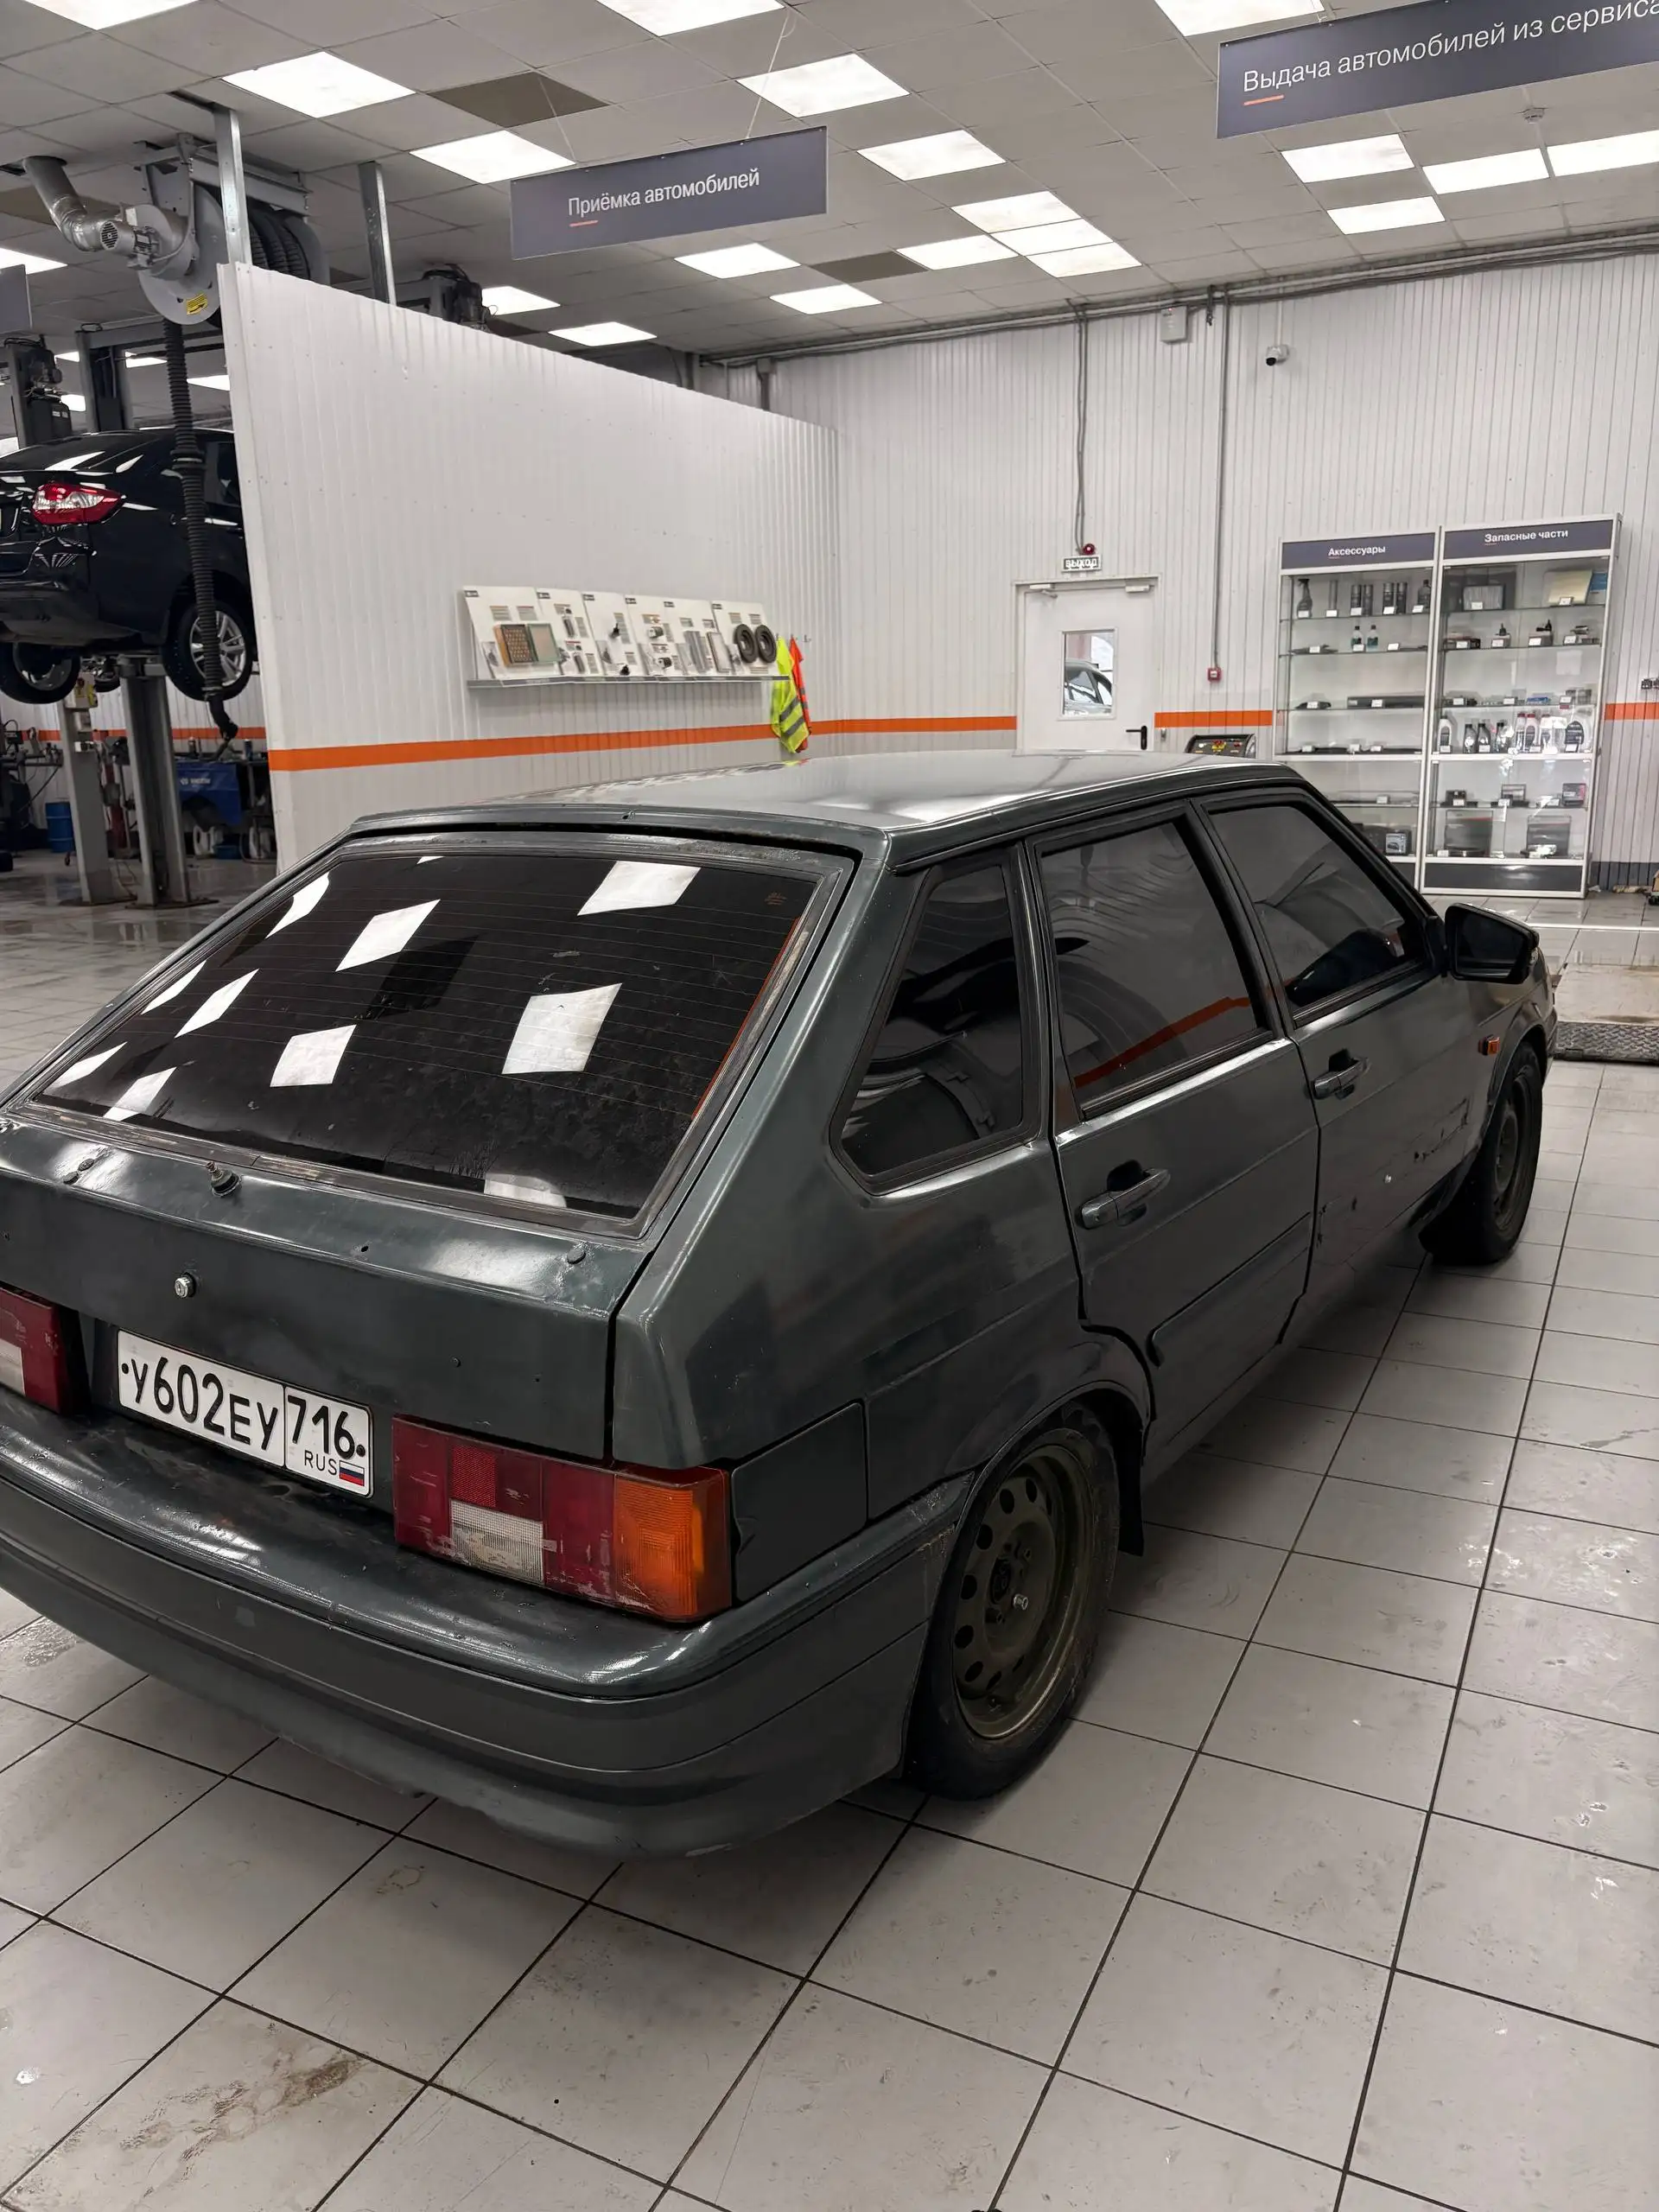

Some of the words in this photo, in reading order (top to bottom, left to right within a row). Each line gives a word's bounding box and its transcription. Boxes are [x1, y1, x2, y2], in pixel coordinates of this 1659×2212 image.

[1243, 60, 1331, 92] Выдача
[1338, 22, 1505, 73] автомобилей
[1514, 20, 1543, 41] из
[569, 190, 641, 217] Приёмка
[645, 168, 760, 204] автомобилей
[1484, 531, 1536, 543] Запасные
[1538, 530, 1568, 538] части
[1065, 558, 1097, 569] ВЫХОД
[1328, 546, 1385, 556] Аксессуары
[288, 1395, 355, 1460] 716
[304, 1450, 337, 1476] RUS
